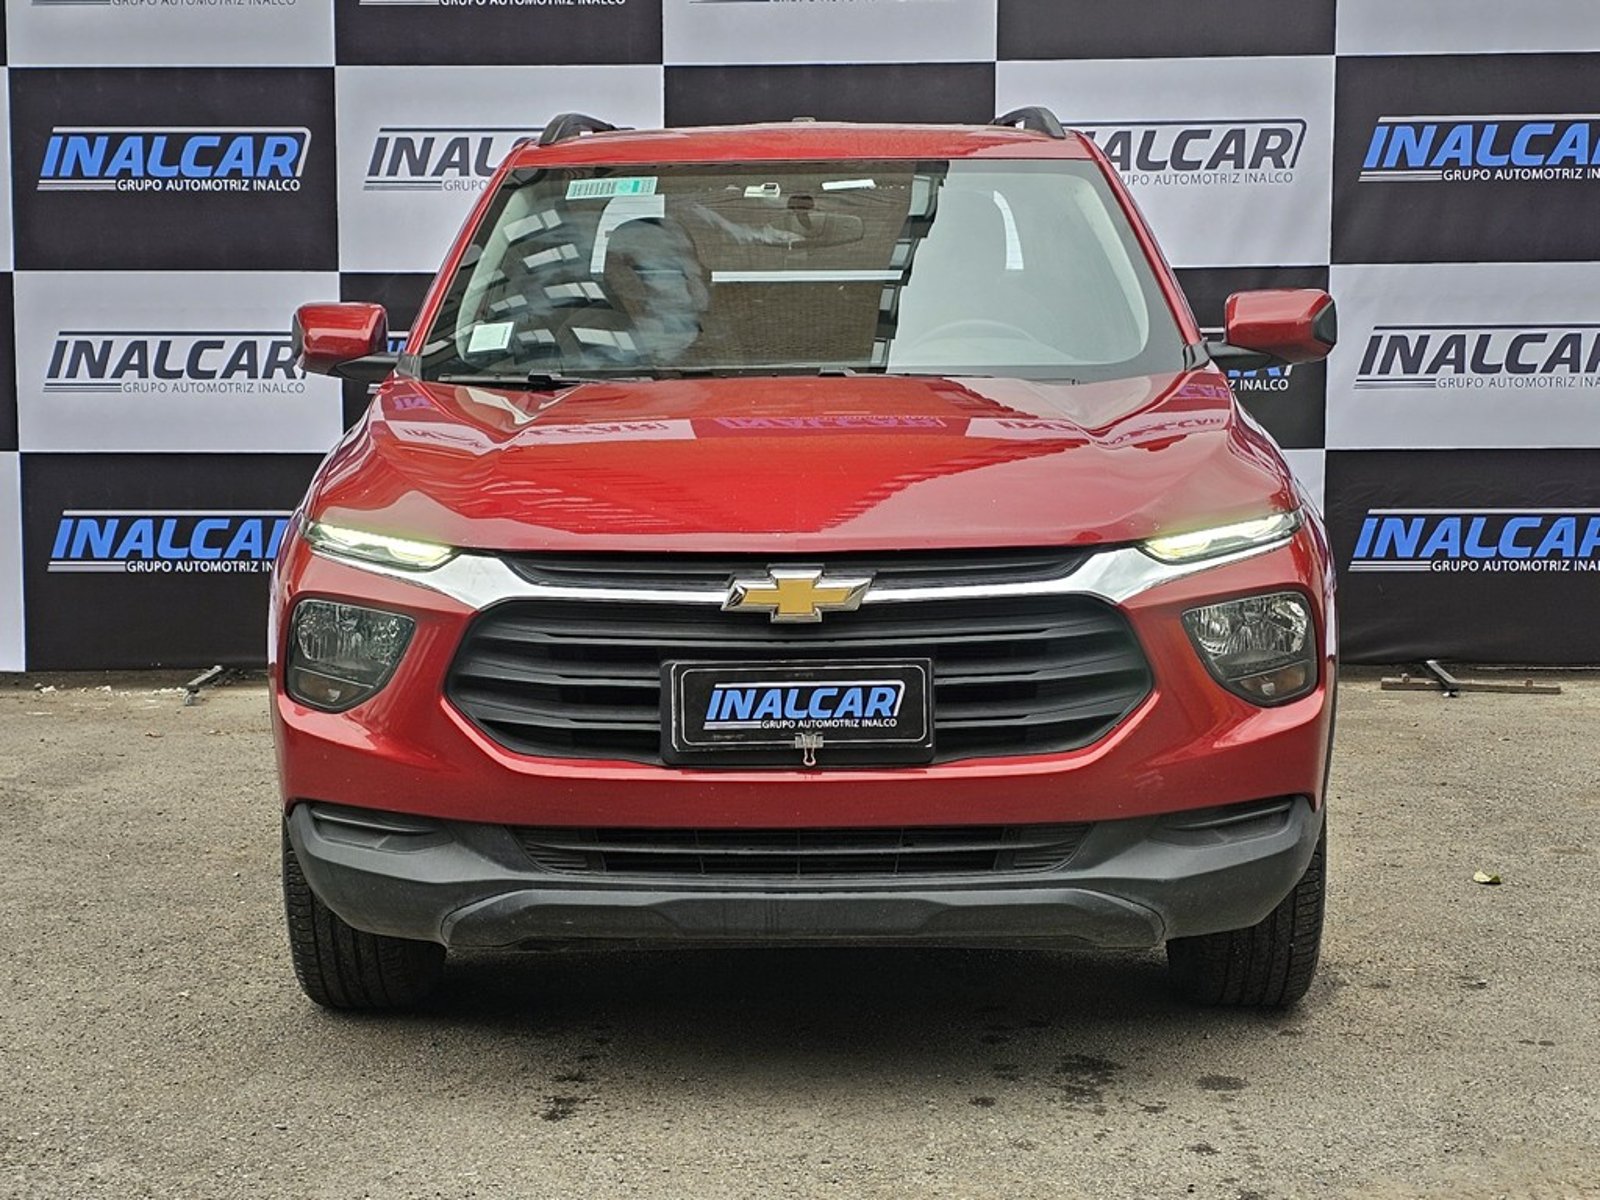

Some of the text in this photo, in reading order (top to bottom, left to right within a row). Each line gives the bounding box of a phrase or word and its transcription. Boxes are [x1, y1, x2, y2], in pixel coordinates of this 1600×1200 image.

[40, 136, 299, 178] INALCAR
[1153, 173, 1240, 186] AUTOMOTRIZ
[1244, 172, 1293, 184] INALCO
[1443, 169, 1491, 181] GRUPO
[1495, 168, 1583, 181] AUTOMOTRIZ
[117, 179, 300, 192] GRUPO AUTOMOTRIZ INALCO
[46, 340, 297, 379] INALCAR
[123, 382, 305, 393] GRUPO AUTOMOTRIZ INALCO
[1240, 379, 1289, 392] INALCO
[1437, 377, 1484, 389] GRUPO
[1489, 376, 1576, 389] AUTOMOTRIZ
[127, 560, 171, 573] GRUPO
[175, 560, 259, 573] AUTOMOTRIZ
[1432, 560, 1479, 572] GRUPO
[1483, 560, 1570, 572] AUTOMOTRIZ
[706, 687, 896, 720] INALCAR
[762, 718, 897, 729] GRUPO AUTOMOTRIZ INALCO
